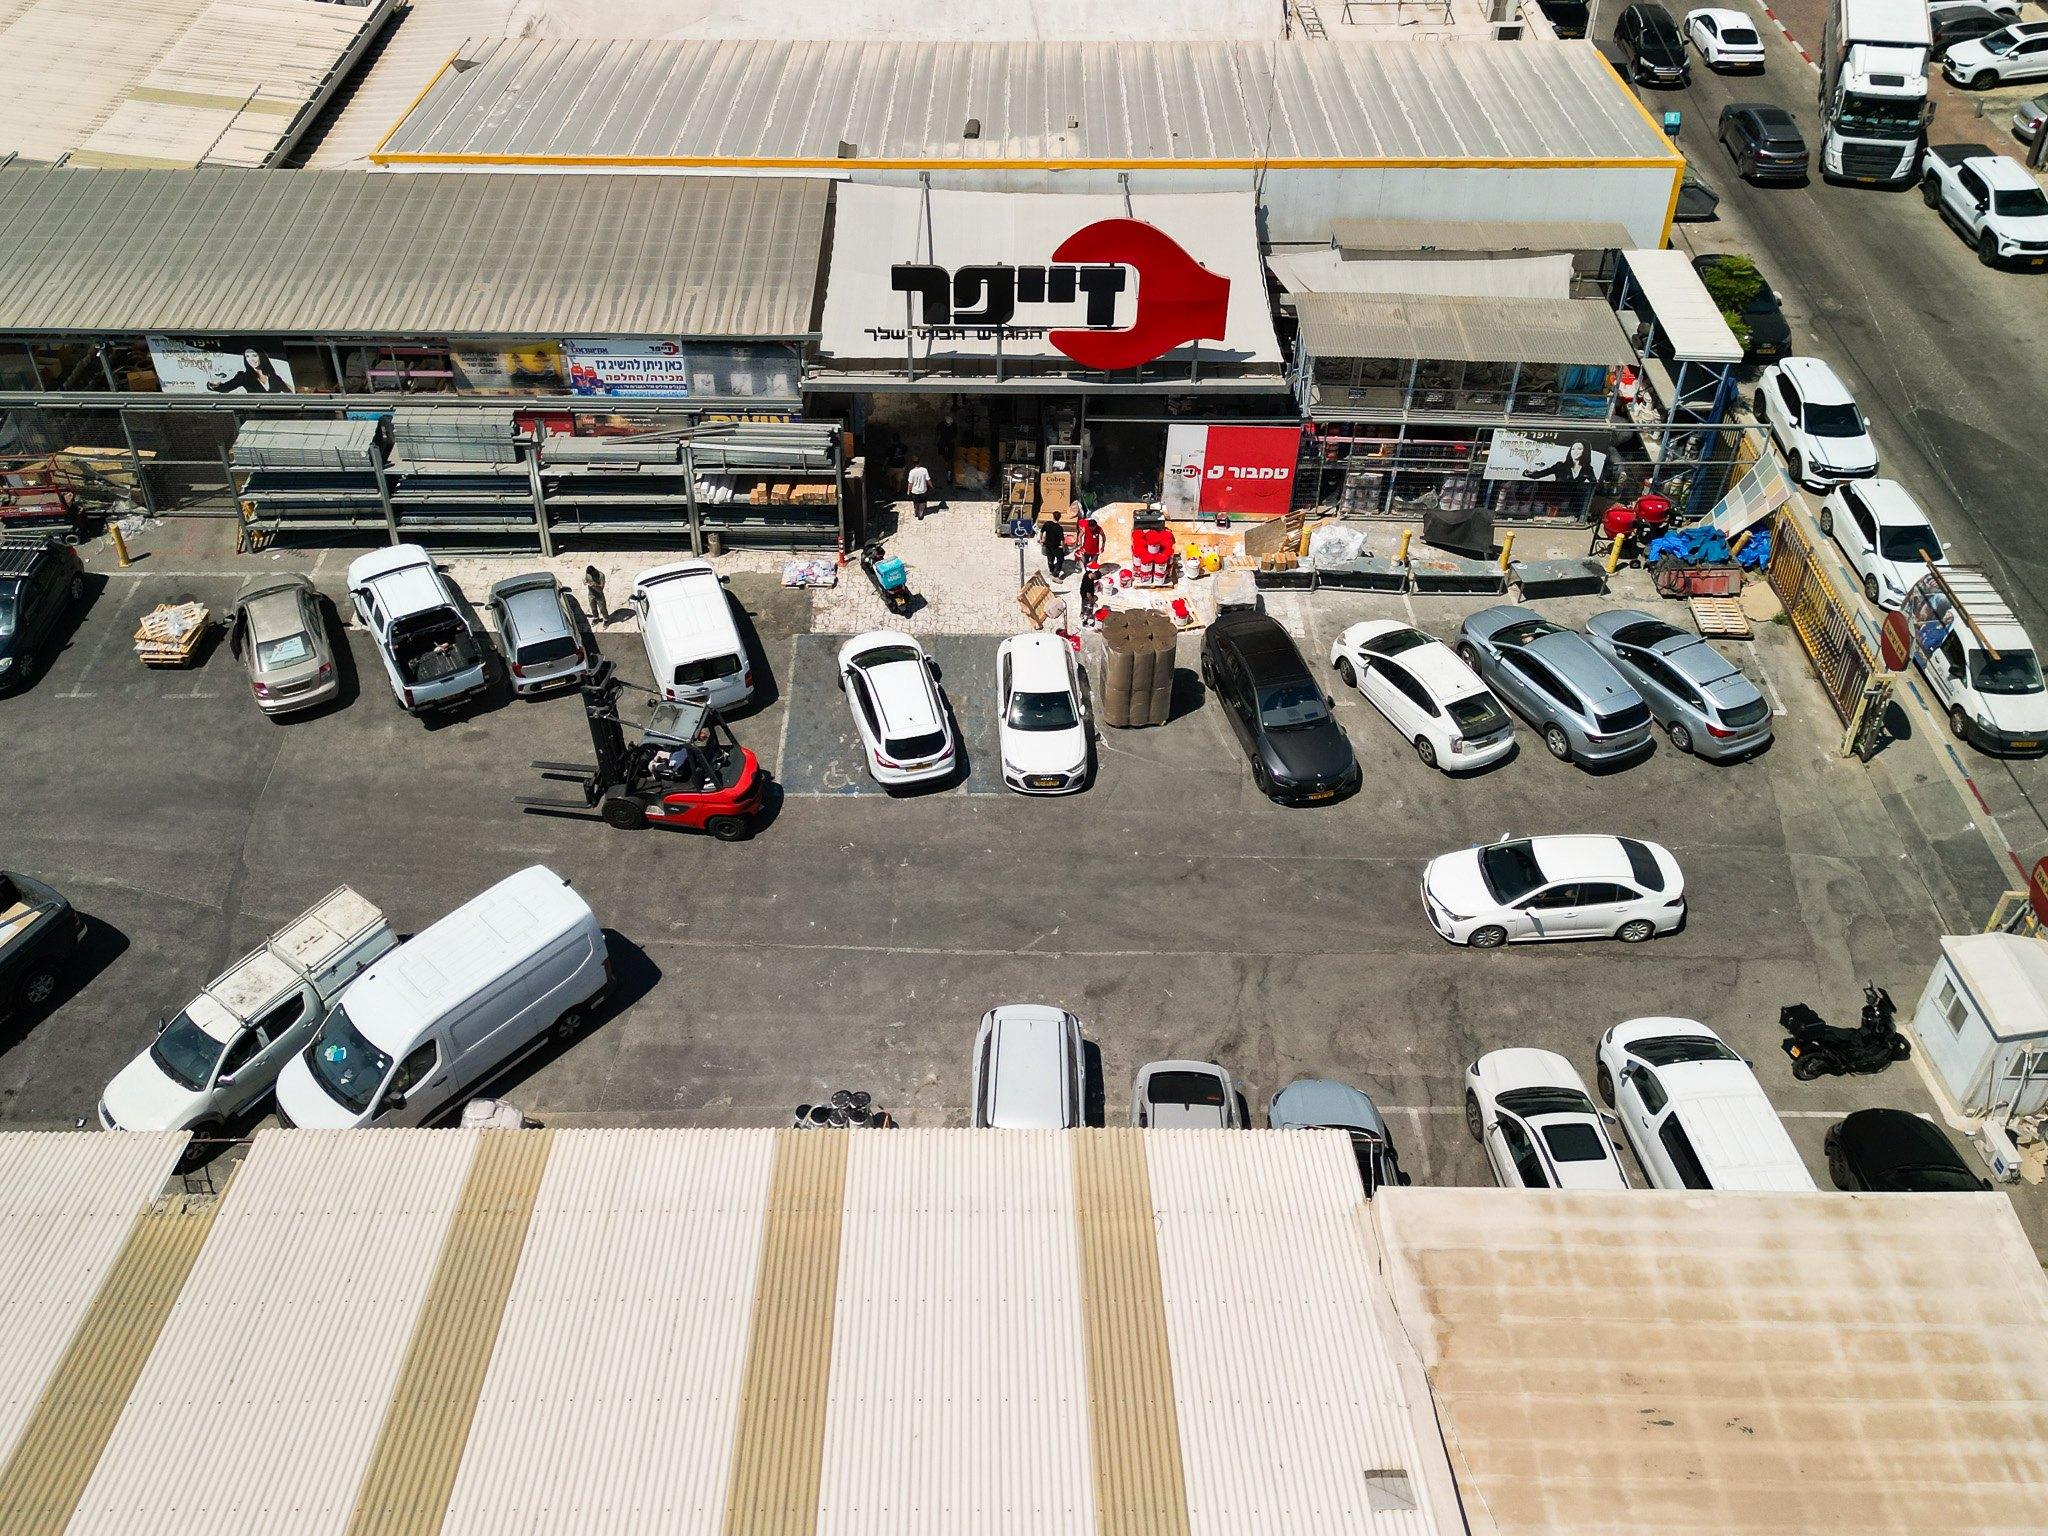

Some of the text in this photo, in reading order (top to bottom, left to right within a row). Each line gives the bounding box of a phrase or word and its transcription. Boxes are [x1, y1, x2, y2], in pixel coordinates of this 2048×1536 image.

[891, 264, 1126, 326] זייפר
[864, 326, 1043, 342] המגרש הביתי שלך
[595, 358, 683, 372] כאן ניתן להשיג גז
[1530, 431, 1559, 440] זייפר
[1228, 466, 1290, 480] טמבור
